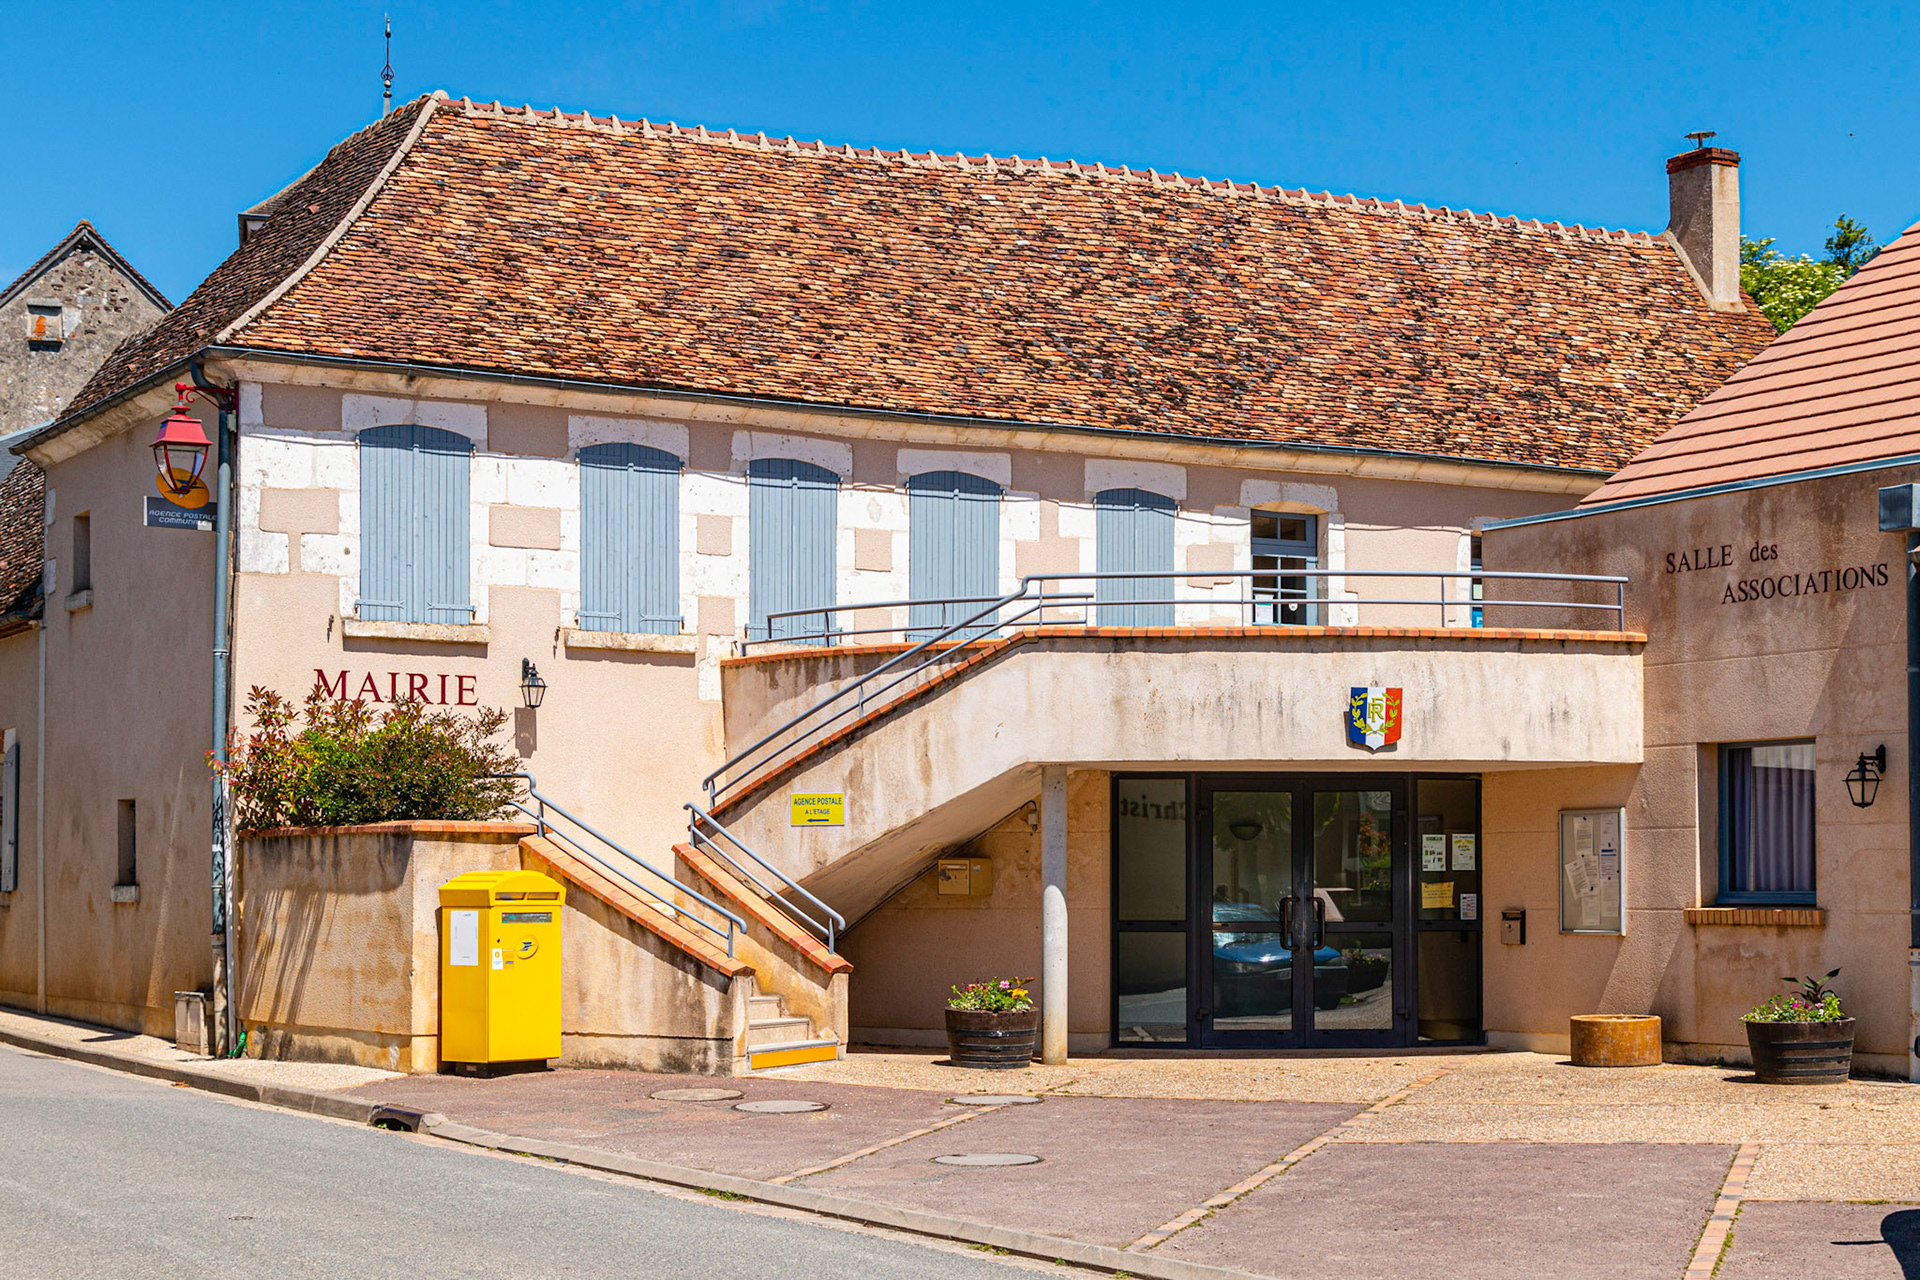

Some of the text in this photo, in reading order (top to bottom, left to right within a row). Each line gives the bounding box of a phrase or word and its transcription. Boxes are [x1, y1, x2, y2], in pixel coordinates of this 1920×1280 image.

[149, 509, 218, 521] AGENCE POSTALE
[1666, 540, 1778, 575] SALLE des
[1721, 562, 1889, 605] ASSOCIATIONS
[313, 668, 480, 706] MAIRIE
[794, 796, 842, 806] AGENCE POSTALE
